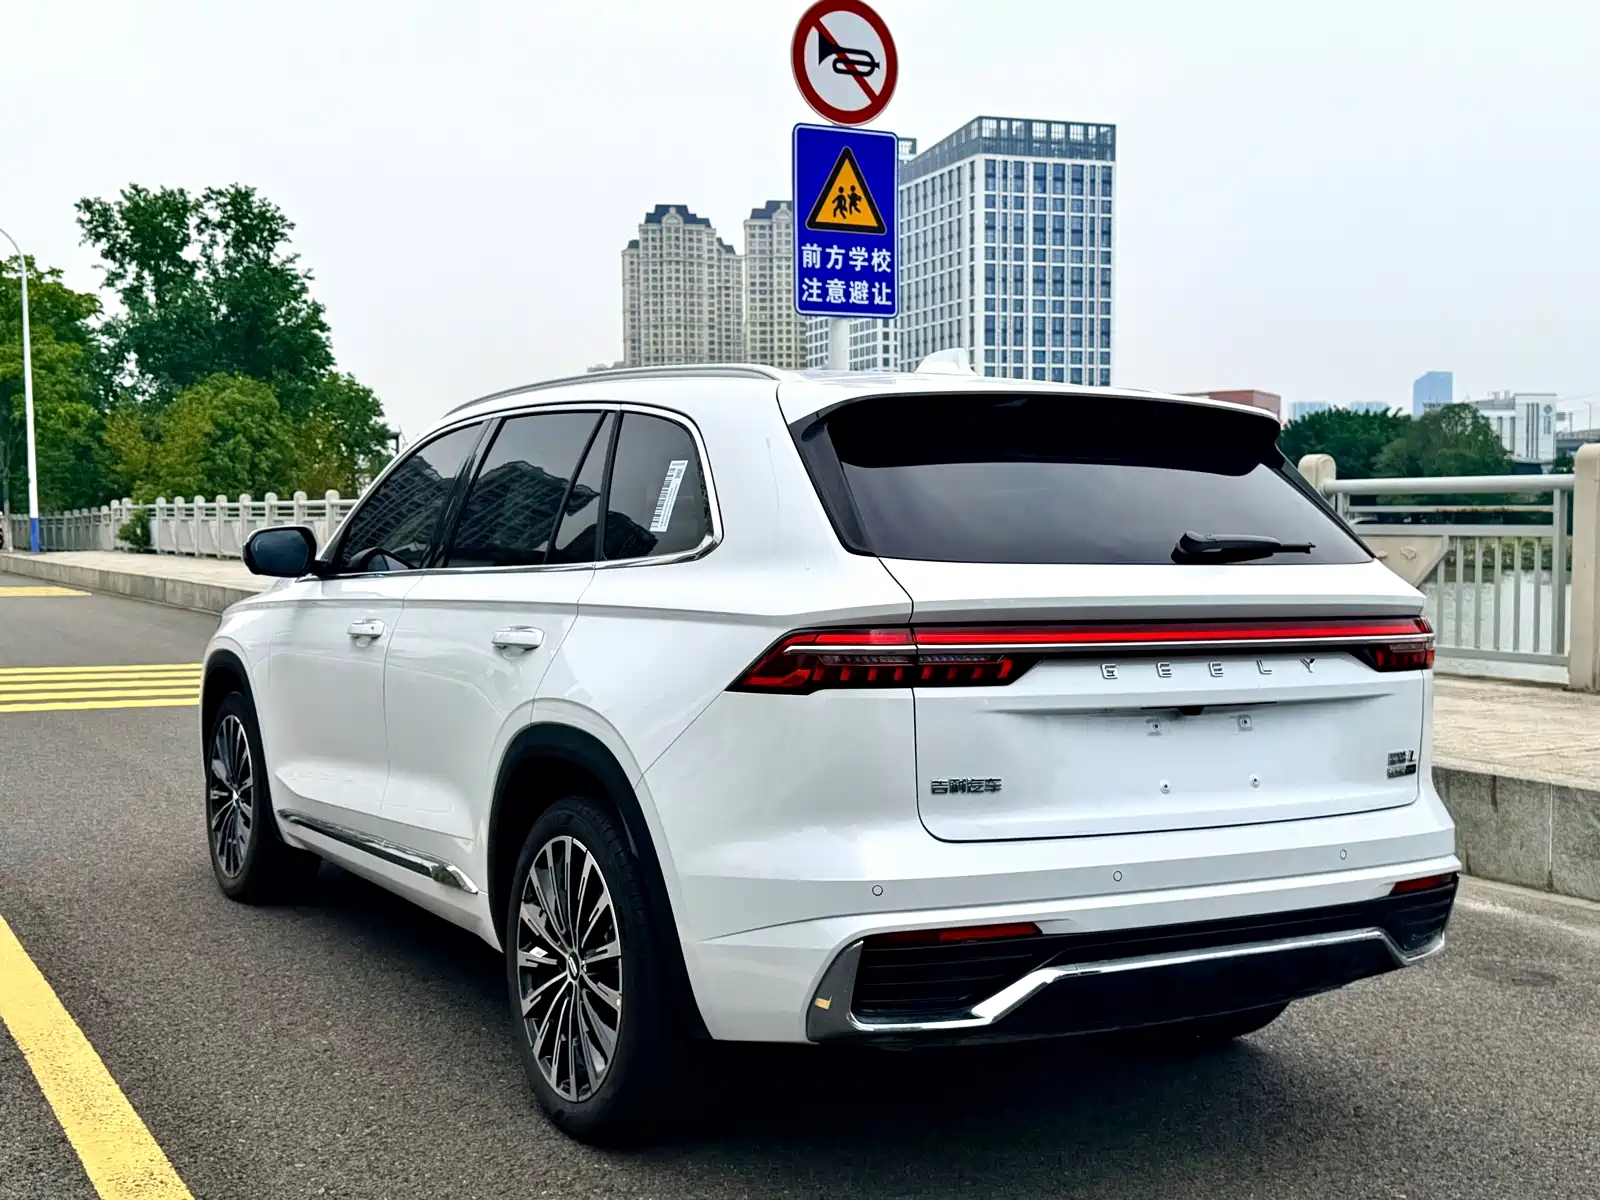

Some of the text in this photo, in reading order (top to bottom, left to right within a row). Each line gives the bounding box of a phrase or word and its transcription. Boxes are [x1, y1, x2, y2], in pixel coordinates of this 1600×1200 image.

[801, 243, 892, 273] 前方学校
[801, 277, 893, 306] 注意避让
[1100, 655, 1316, 680] GEELY
